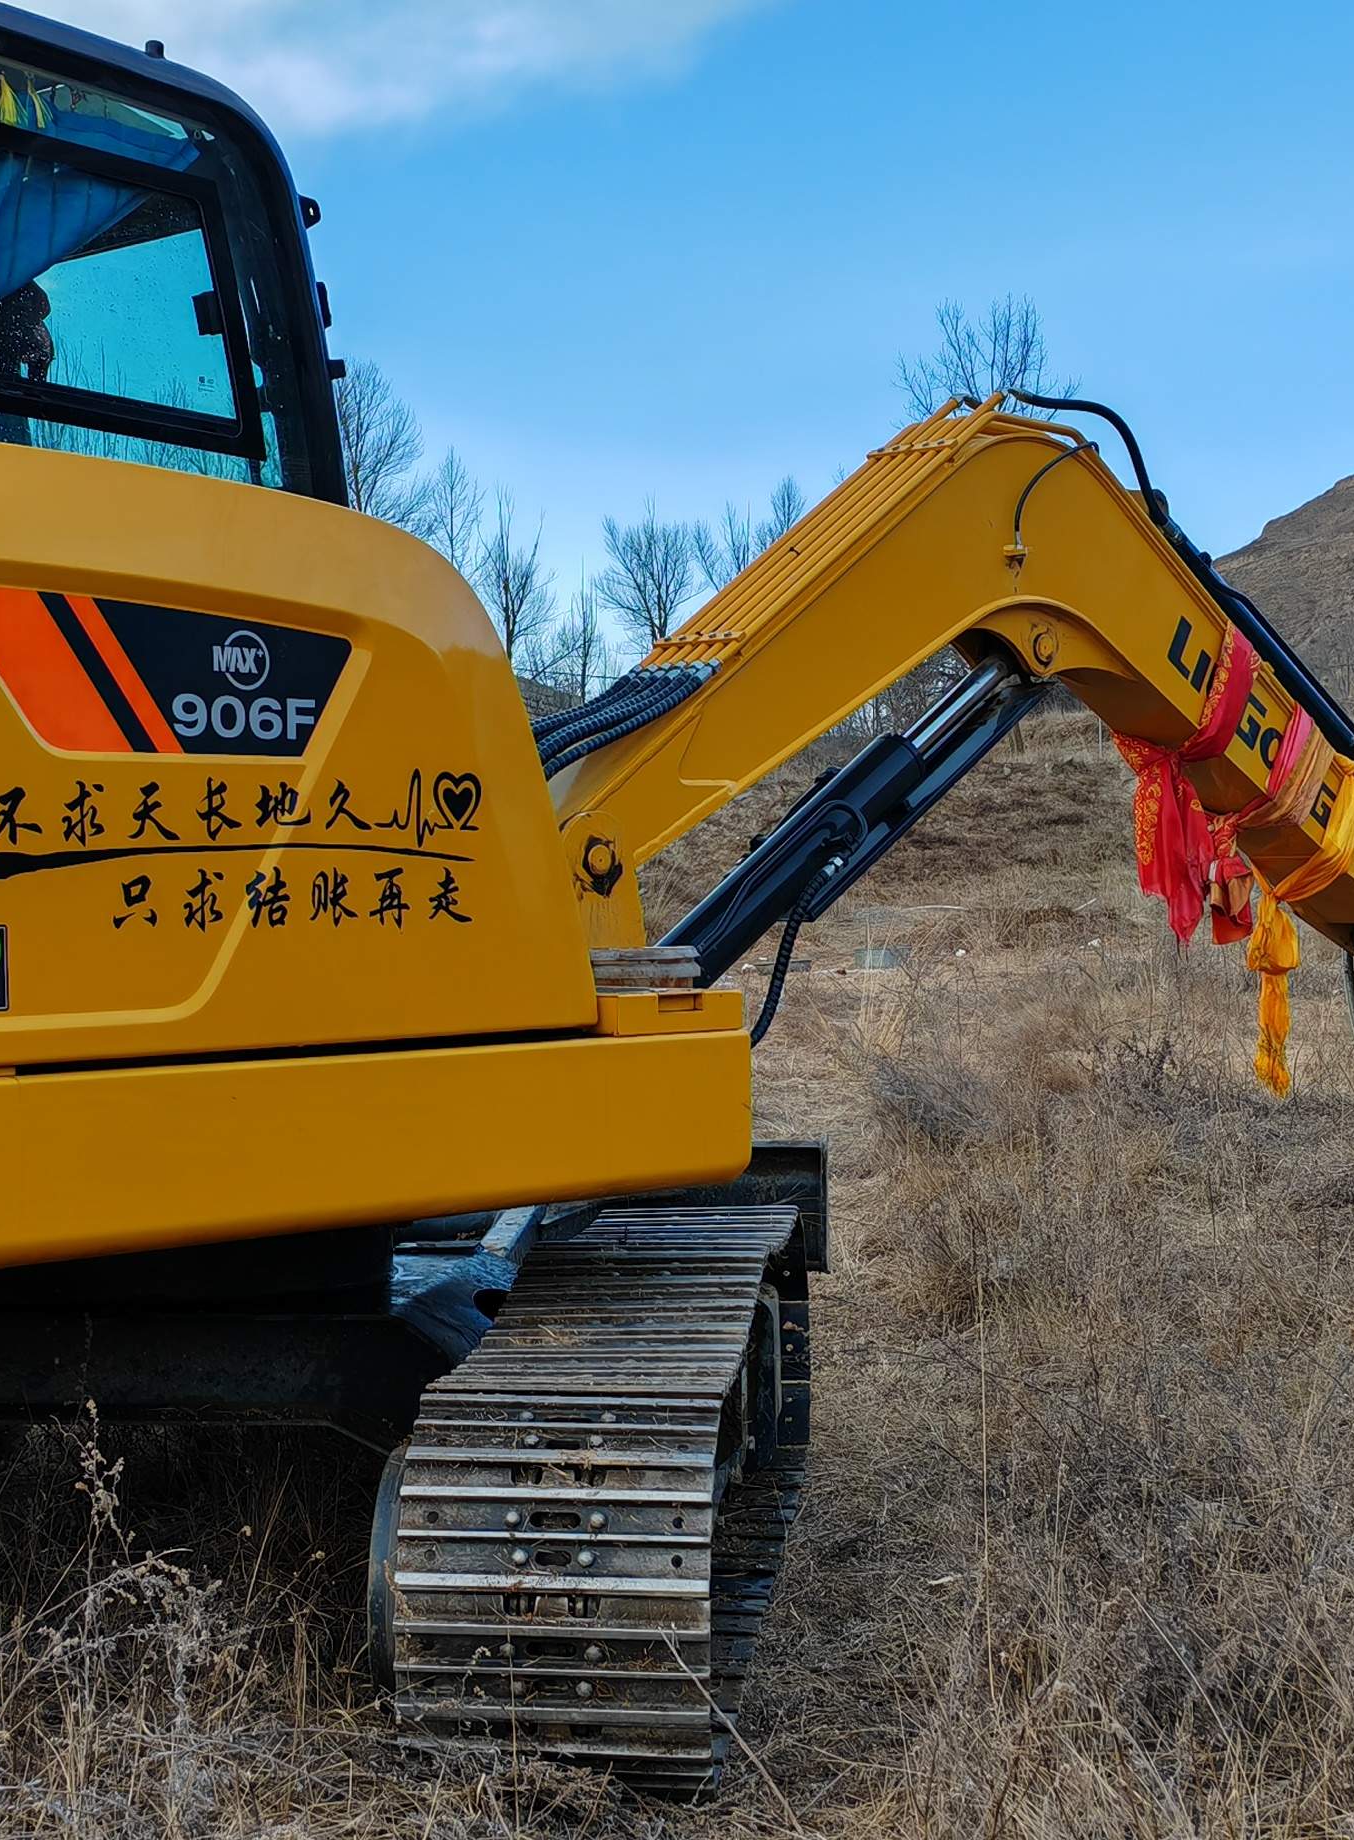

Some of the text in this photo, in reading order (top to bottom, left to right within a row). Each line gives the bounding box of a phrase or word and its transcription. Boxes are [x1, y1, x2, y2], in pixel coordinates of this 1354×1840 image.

[171, 693, 316, 740] 906F
[112, 866, 475, 933] 只求结账再走
